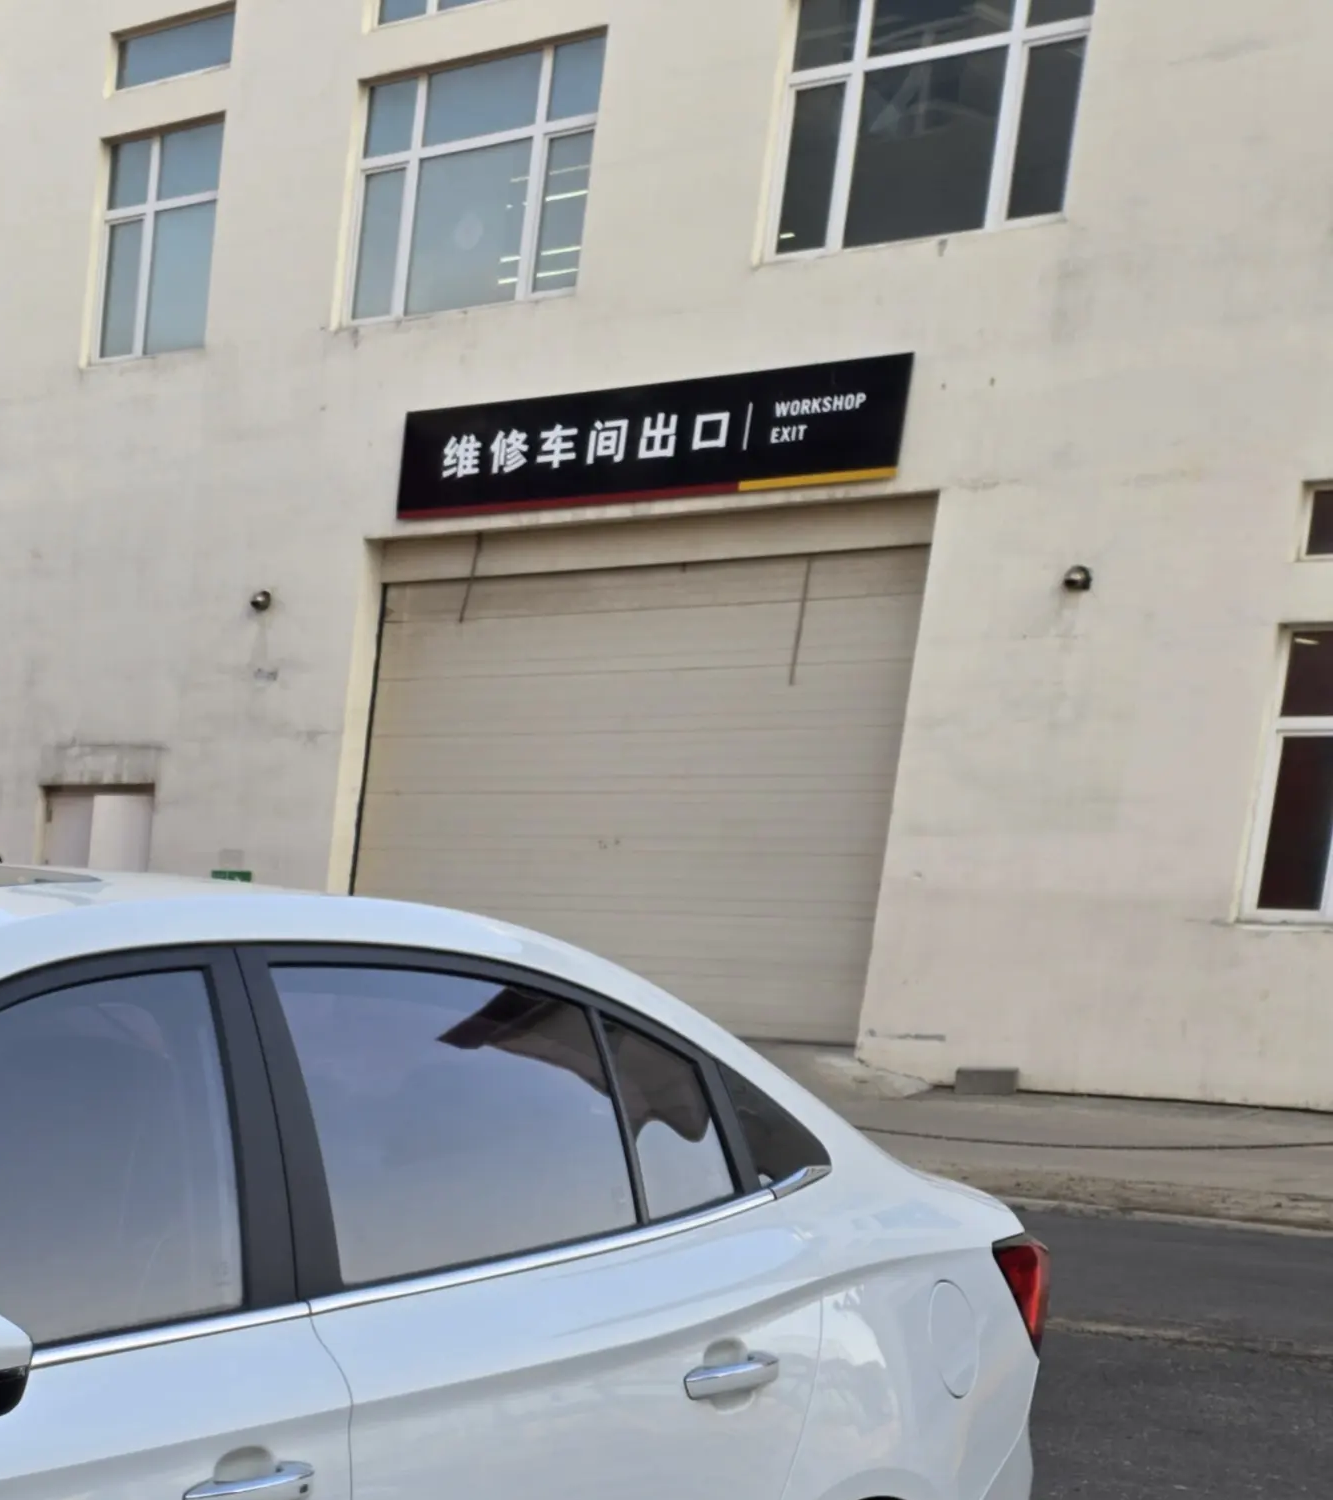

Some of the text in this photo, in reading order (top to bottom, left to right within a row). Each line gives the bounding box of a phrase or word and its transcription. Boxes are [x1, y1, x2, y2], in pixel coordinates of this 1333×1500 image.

[774, 392, 867, 419] WORKSHOP
[441, 411, 731, 479] 维修车间出口
[770, 424, 808, 444] EXIT
